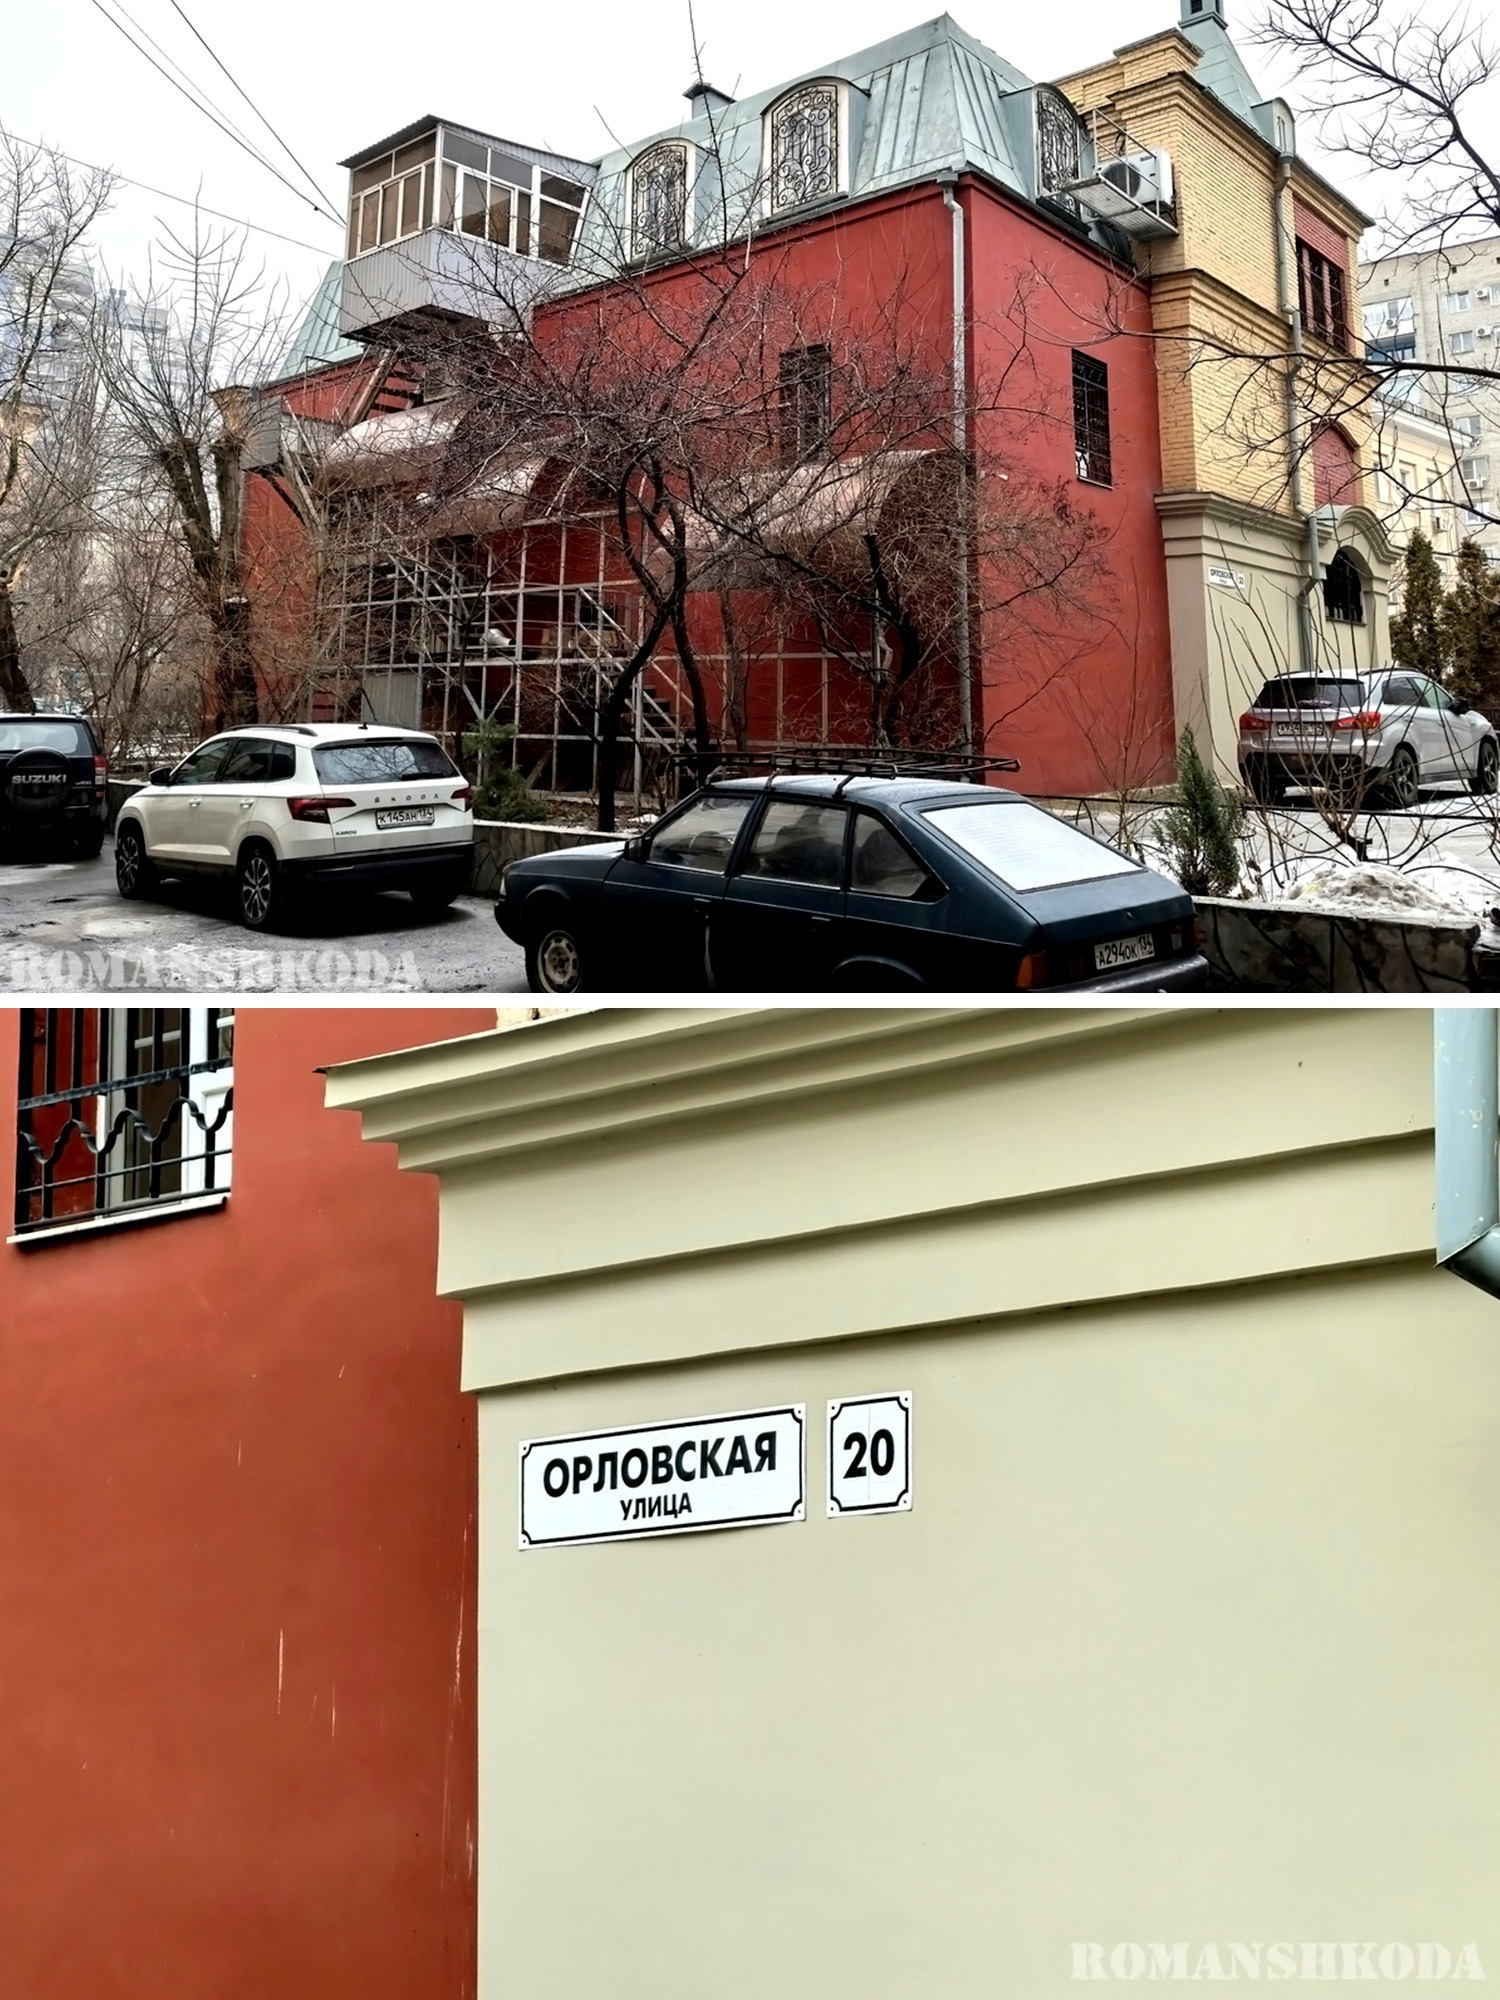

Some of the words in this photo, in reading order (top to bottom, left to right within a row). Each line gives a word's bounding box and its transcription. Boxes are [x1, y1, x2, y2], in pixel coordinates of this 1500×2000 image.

[12, 774, 67, 784] SUZUKI
[543, 1430, 778, 1498] ОРЛОВСКАЯ
[843, 1428, 895, 1479] 20
[620, 1492, 692, 1521] УЛИЦА
